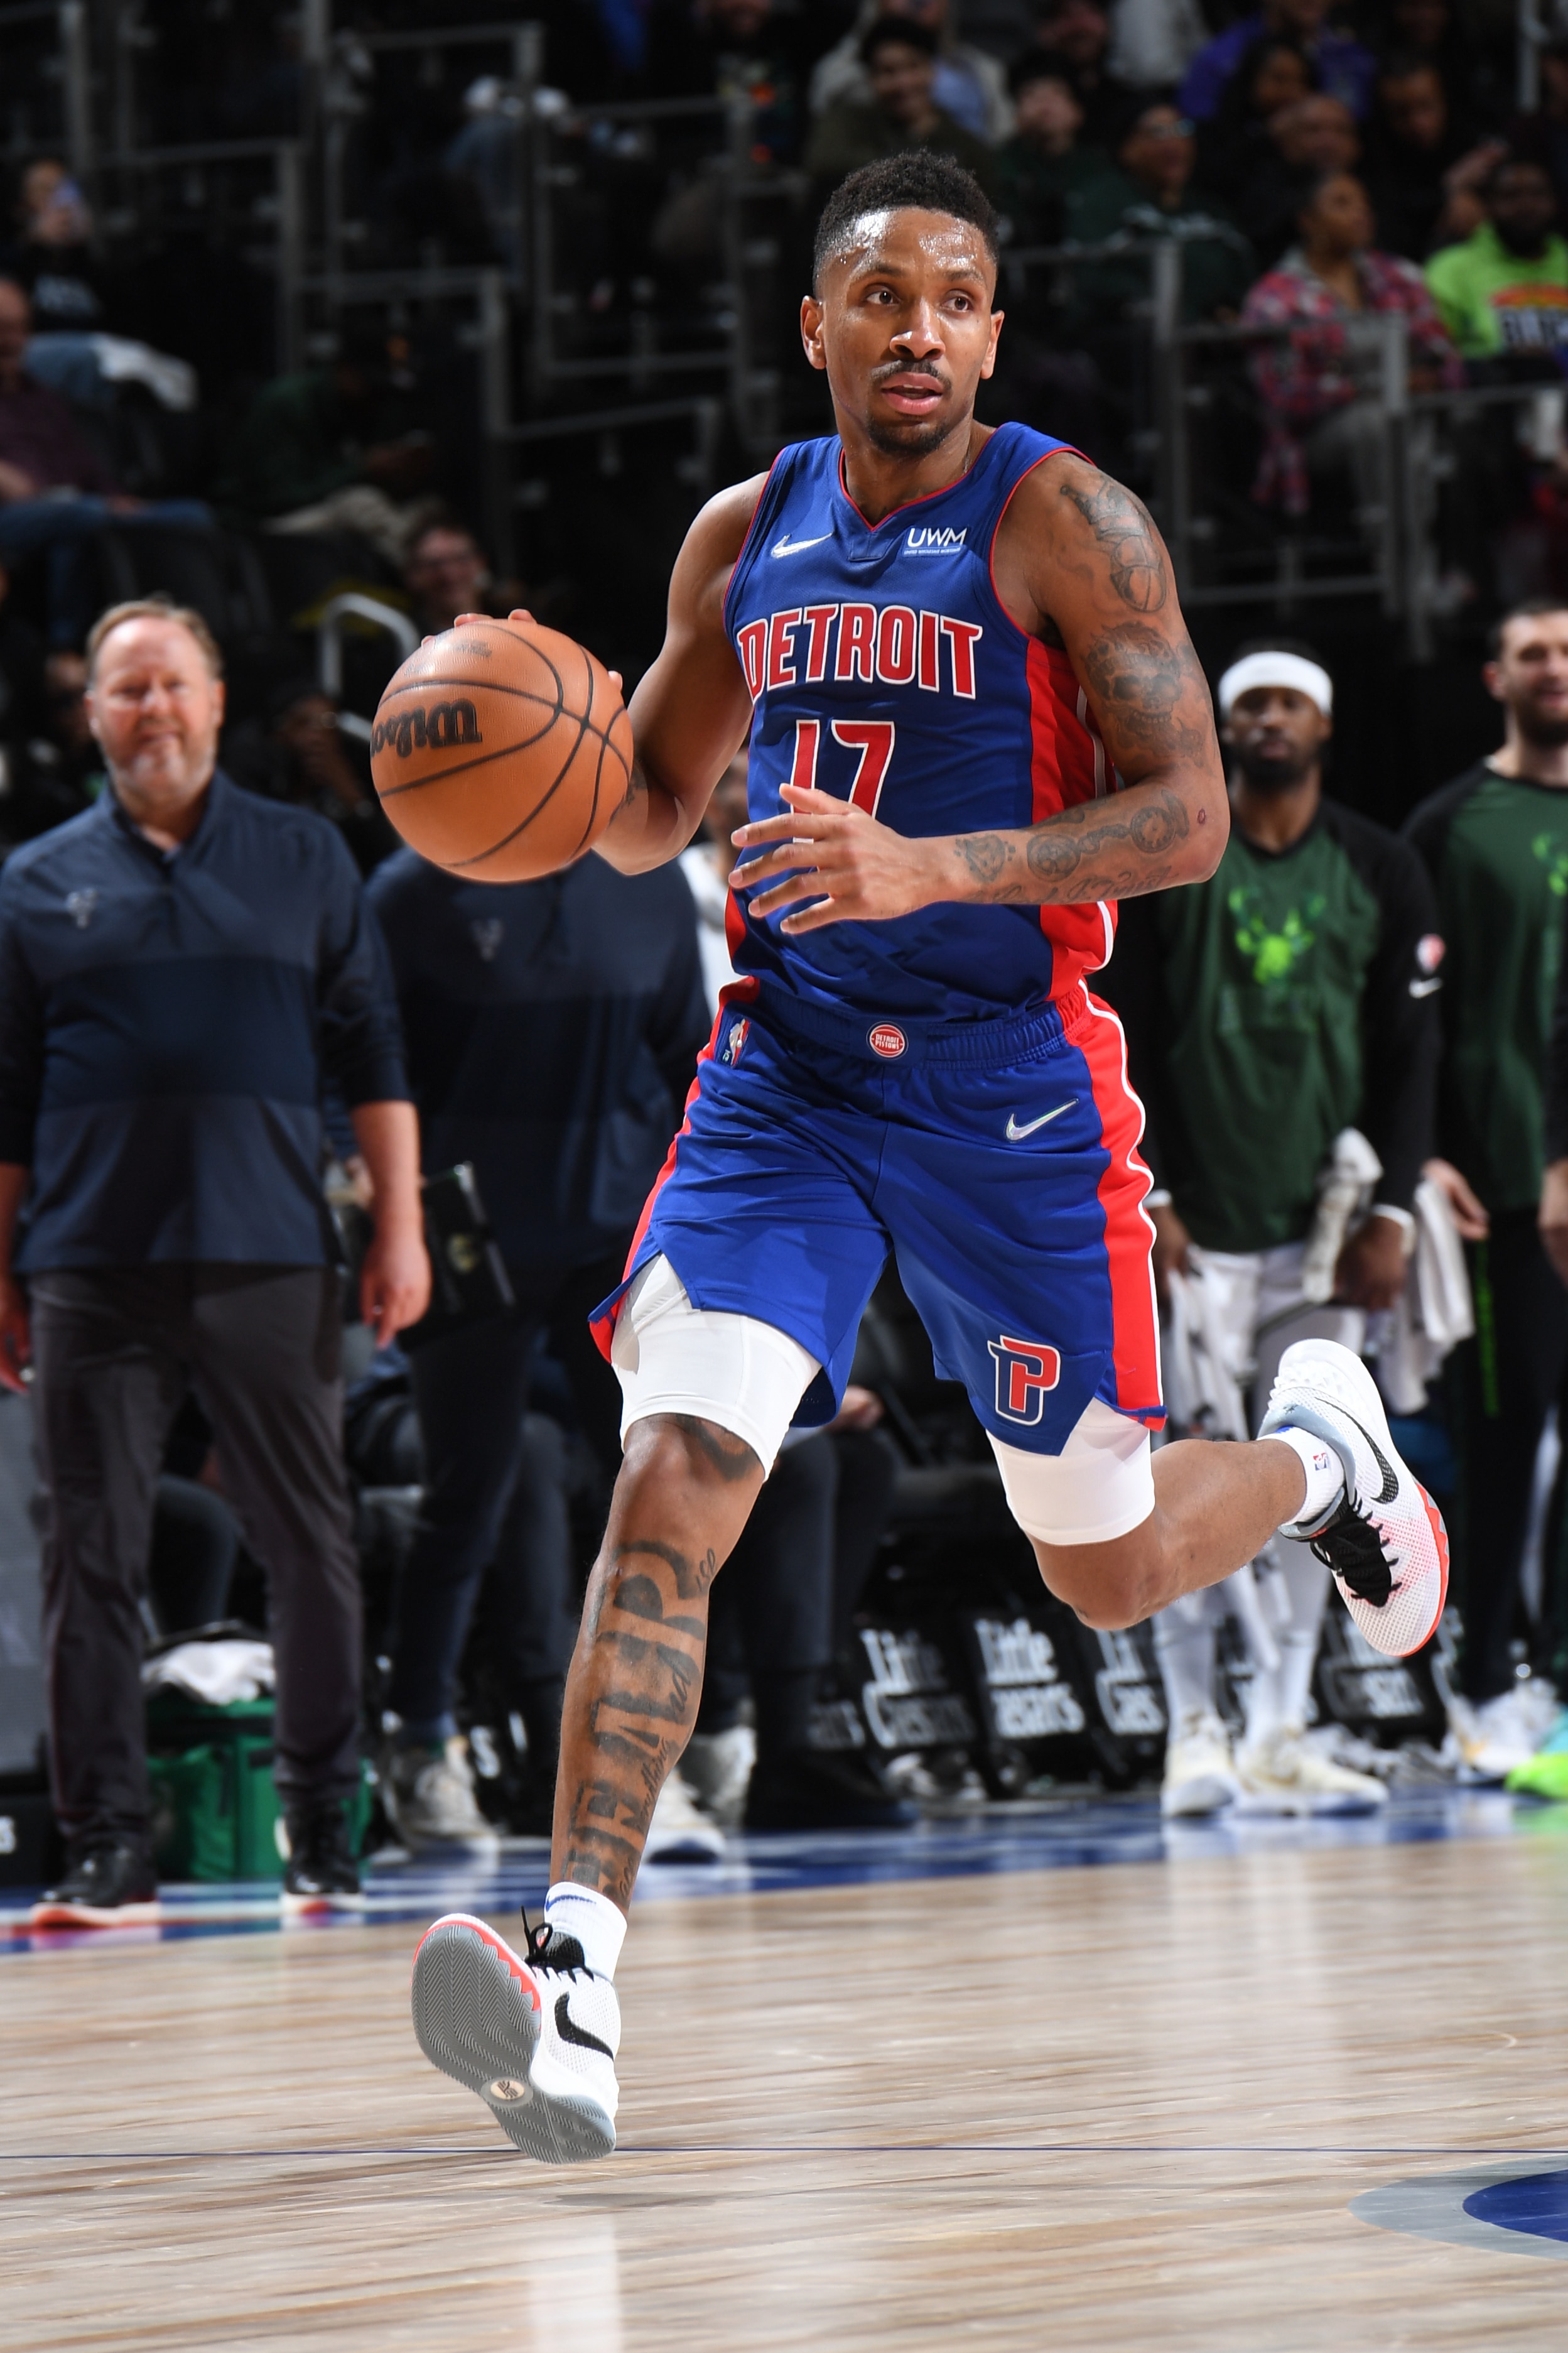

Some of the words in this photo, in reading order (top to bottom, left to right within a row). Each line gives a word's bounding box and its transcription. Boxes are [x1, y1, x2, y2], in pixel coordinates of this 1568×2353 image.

[907, 528, 967, 547] UWM
[737, 603, 983, 705] DETROIT
[791, 719, 895, 843] 17
[875, 1033, 899, 1044] DETROIT
[875, 1040, 899, 1050] PISTONS
